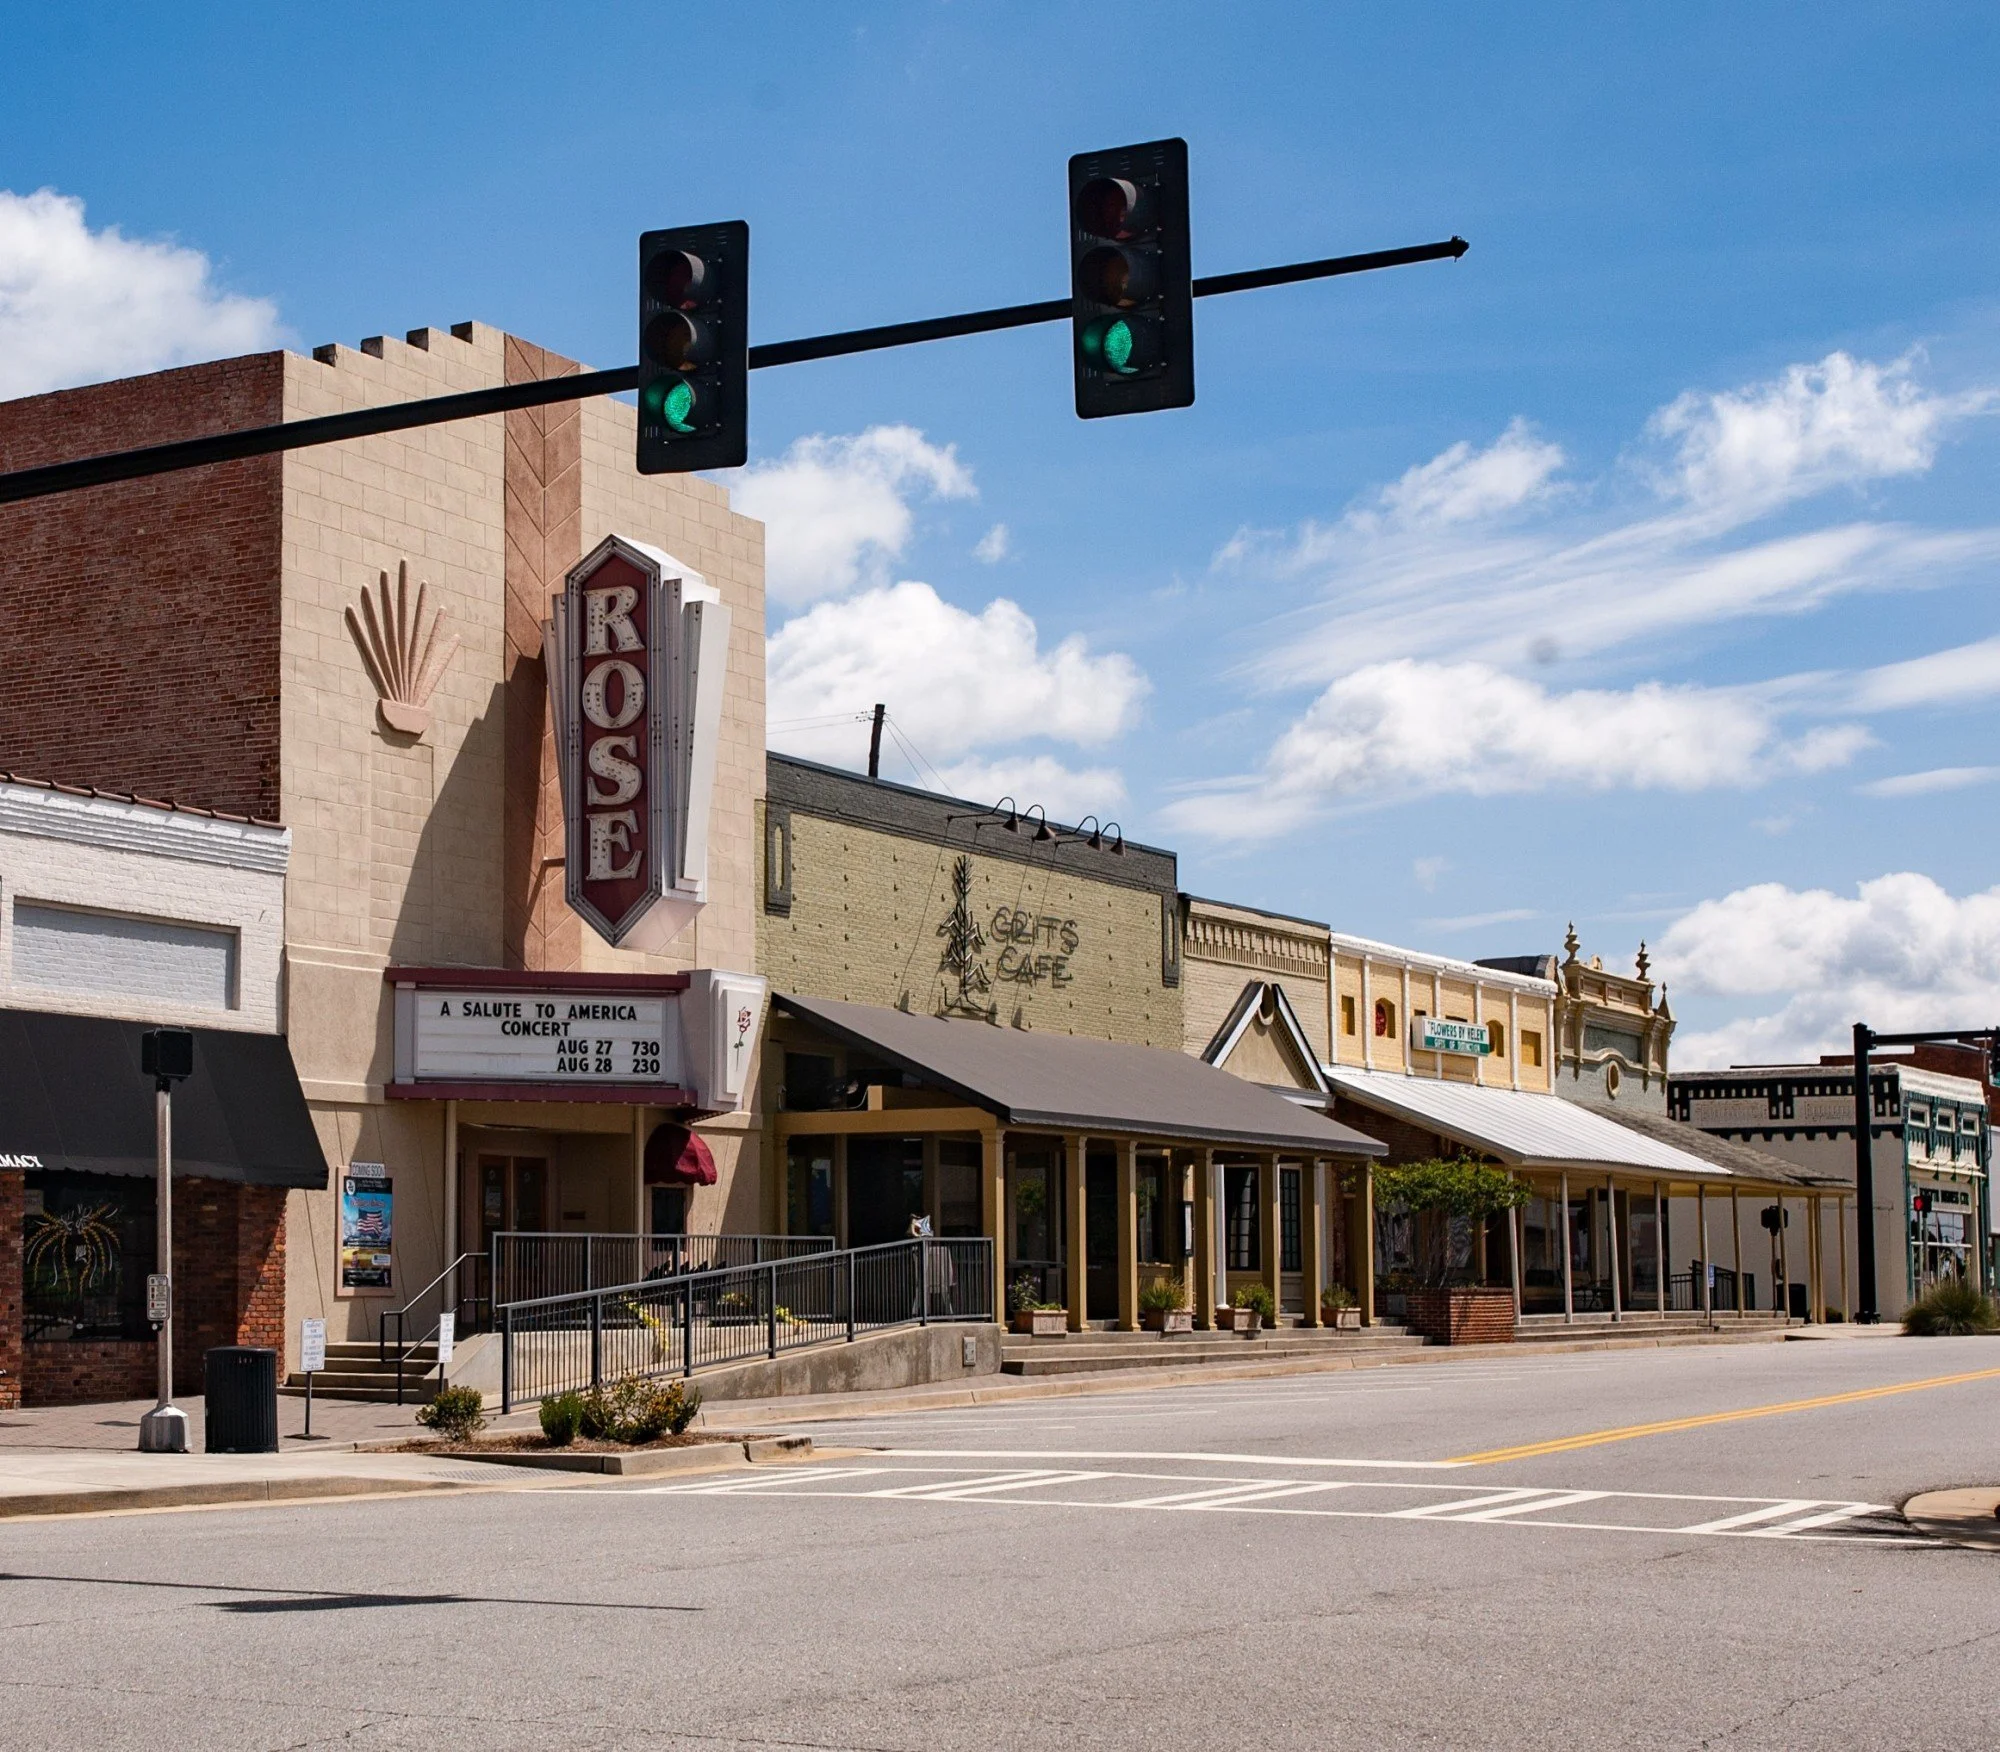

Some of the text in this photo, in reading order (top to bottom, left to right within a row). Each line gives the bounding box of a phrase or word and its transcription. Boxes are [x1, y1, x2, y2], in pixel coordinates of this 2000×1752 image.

[581, 584, 646, 882] ROSE
[998, 945, 1073, 989] CAFE
[440, 1001, 638, 1021] A SALUTE TO AMERICA
[501, 1020, 571, 1037] CONCERT
[557, 1039, 660, 1057] AUG 27 730
[557, 1056, 660, 1075] AUG 28 230
